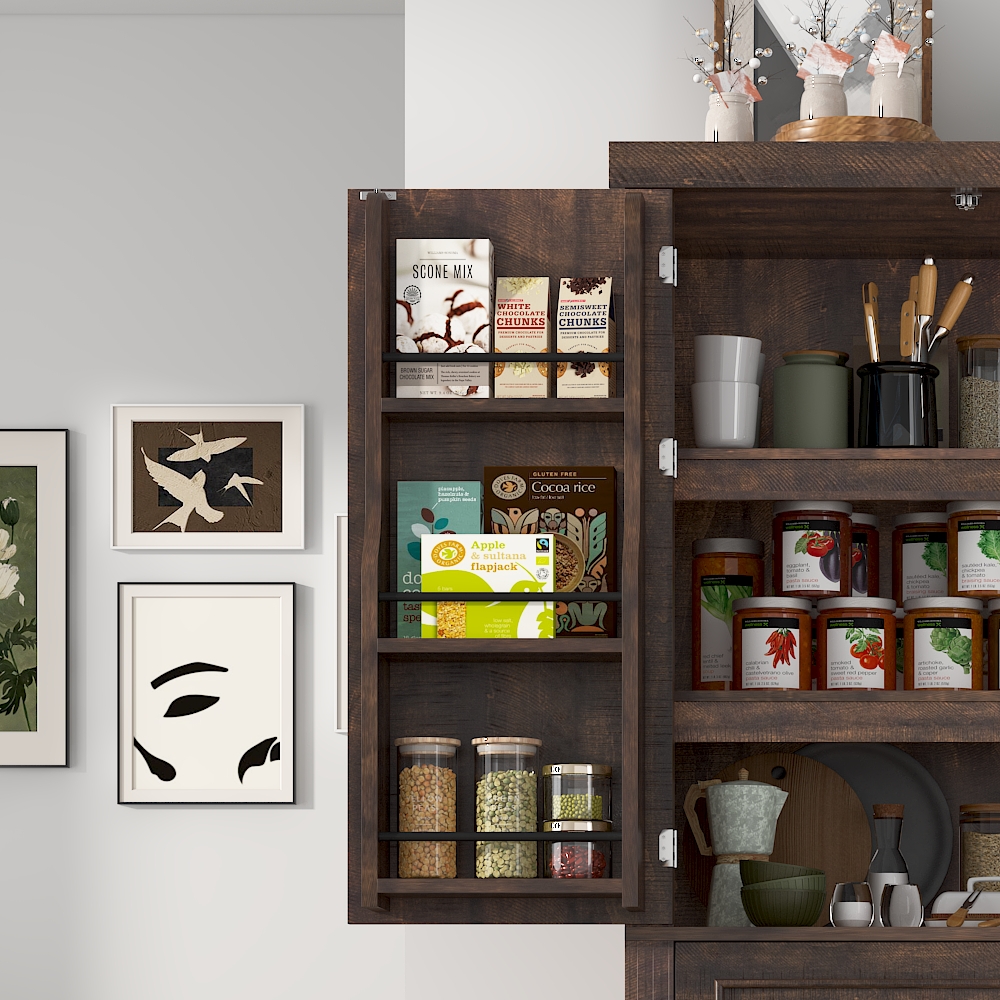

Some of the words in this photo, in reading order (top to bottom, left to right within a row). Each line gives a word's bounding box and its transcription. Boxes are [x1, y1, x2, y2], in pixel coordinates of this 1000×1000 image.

[412, 264, 448, 278] SCONE
[453, 264, 473, 278] MIX
[559, 318, 607, 326] CHUNKS
[532, 482, 570, 493] Cocoa
[573, 482, 596, 493] rice
[496, 489, 523, 498] ORGANIC
[471, 541, 505, 551] Apple
[438, 553, 463, 565] ORGANIC
[471, 552, 480, 560] &
[483, 552, 526, 560] sultana
[471, 563, 518, 572] flapjack
